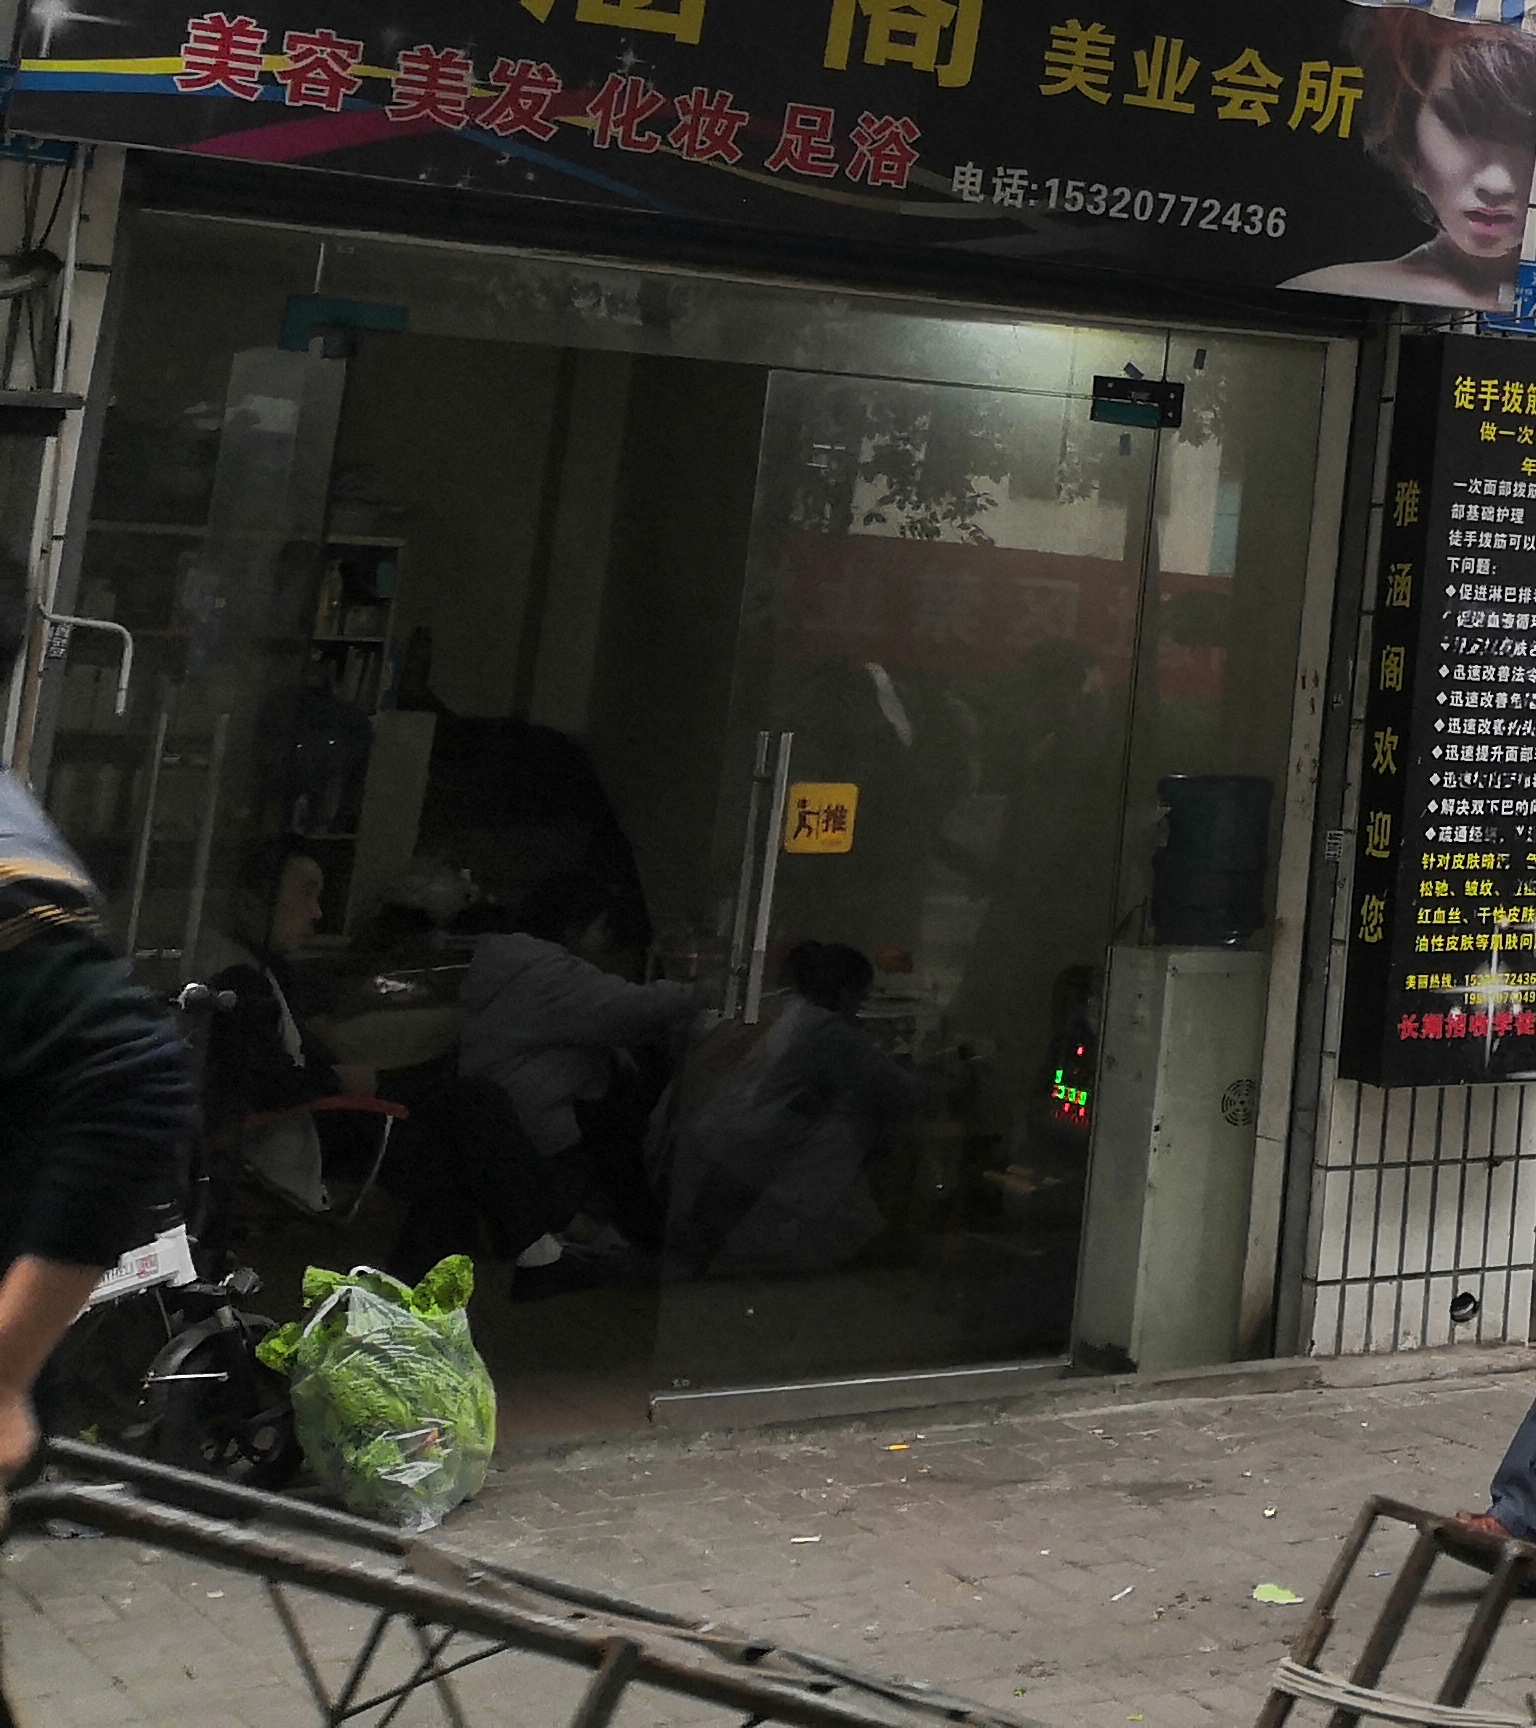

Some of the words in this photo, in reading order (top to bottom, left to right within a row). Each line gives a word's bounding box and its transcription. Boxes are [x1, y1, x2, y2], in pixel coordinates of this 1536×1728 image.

[1038, 18, 1366, 139] 美业会所
[1480, 420, 1535, 446] 做一次
[1450, 502, 1526, 526] 部基础护理
